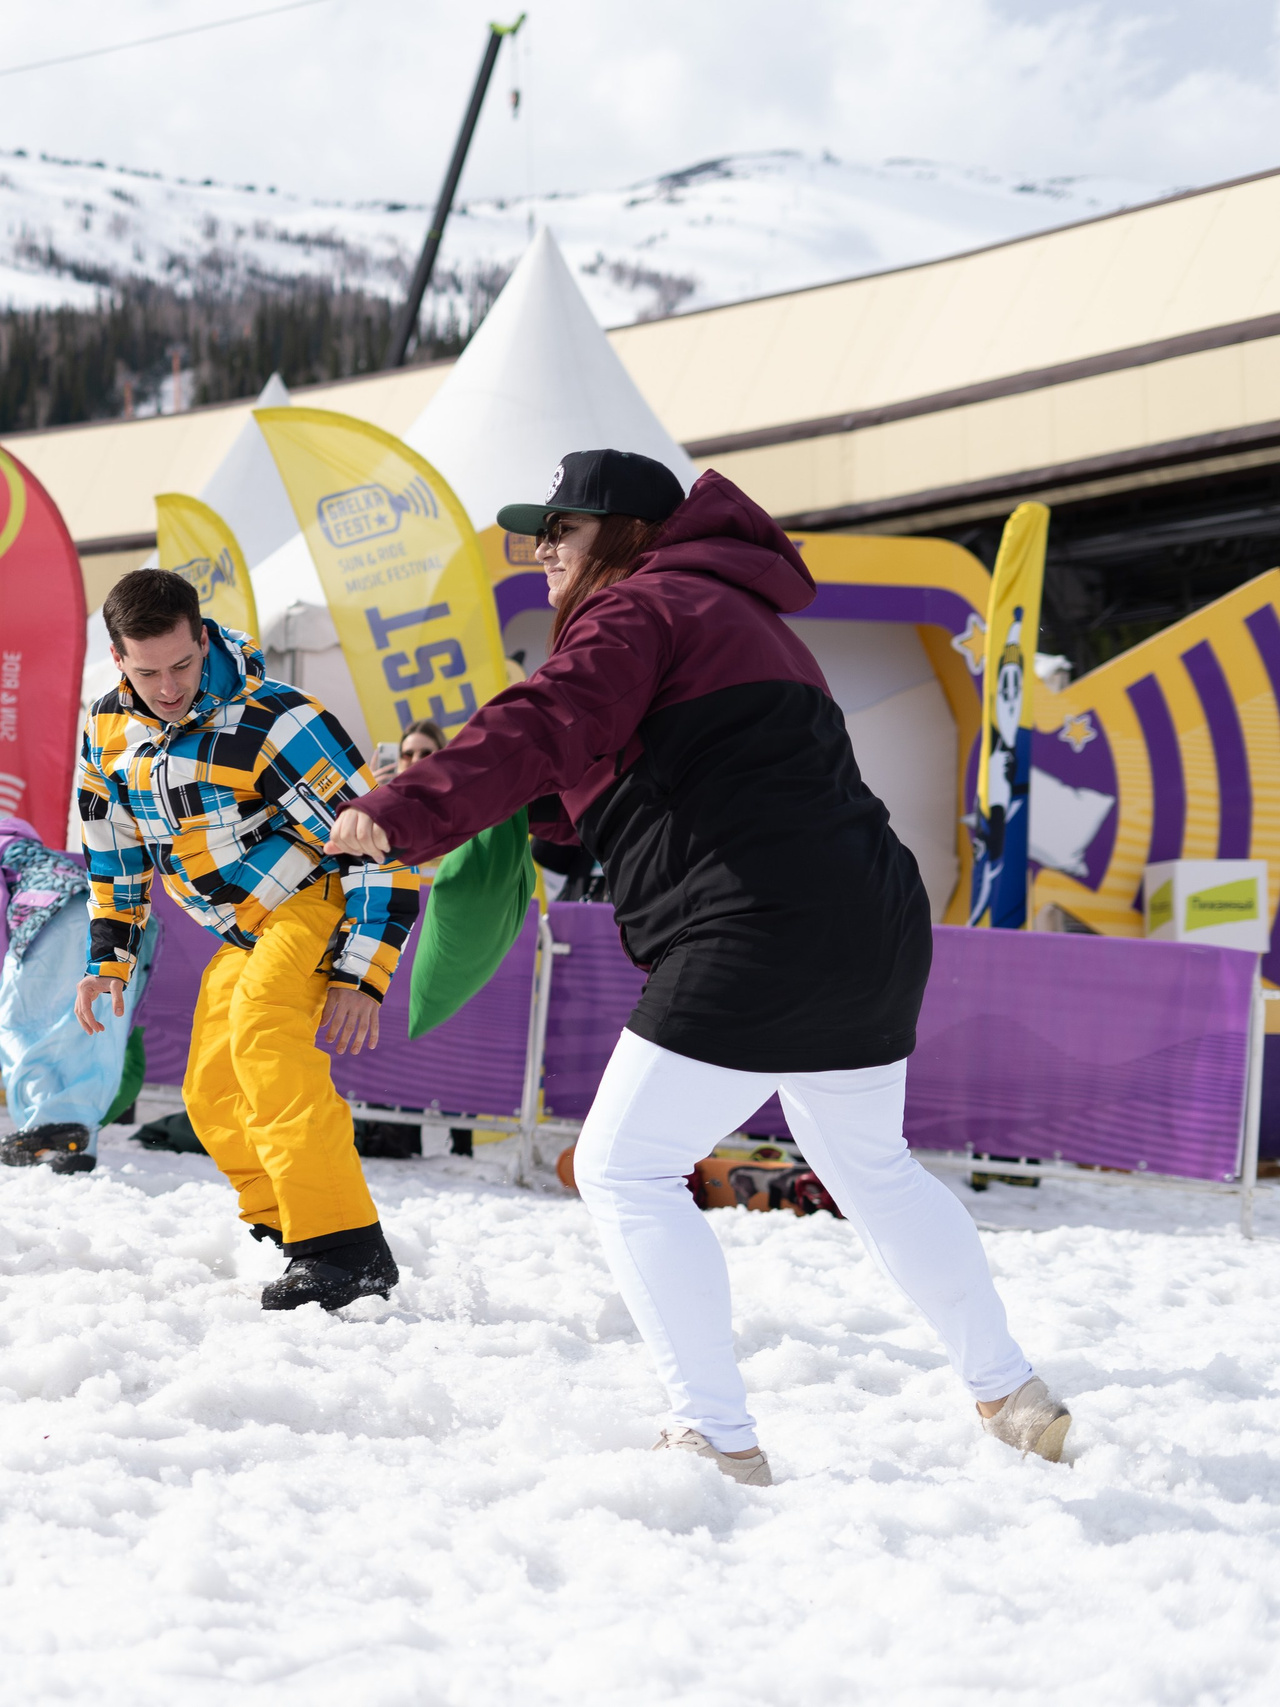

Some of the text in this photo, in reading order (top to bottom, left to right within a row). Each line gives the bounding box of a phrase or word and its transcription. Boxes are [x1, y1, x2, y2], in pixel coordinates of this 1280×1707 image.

[326, 491, 384, 520] GRELKA
[334, 515, 372, 540] FEST
[338, 555, 365, 573] SUN
[377, 542, 407, 563] RIDE
[345, 556, 443, 594] MUSIC FESTIVAL
